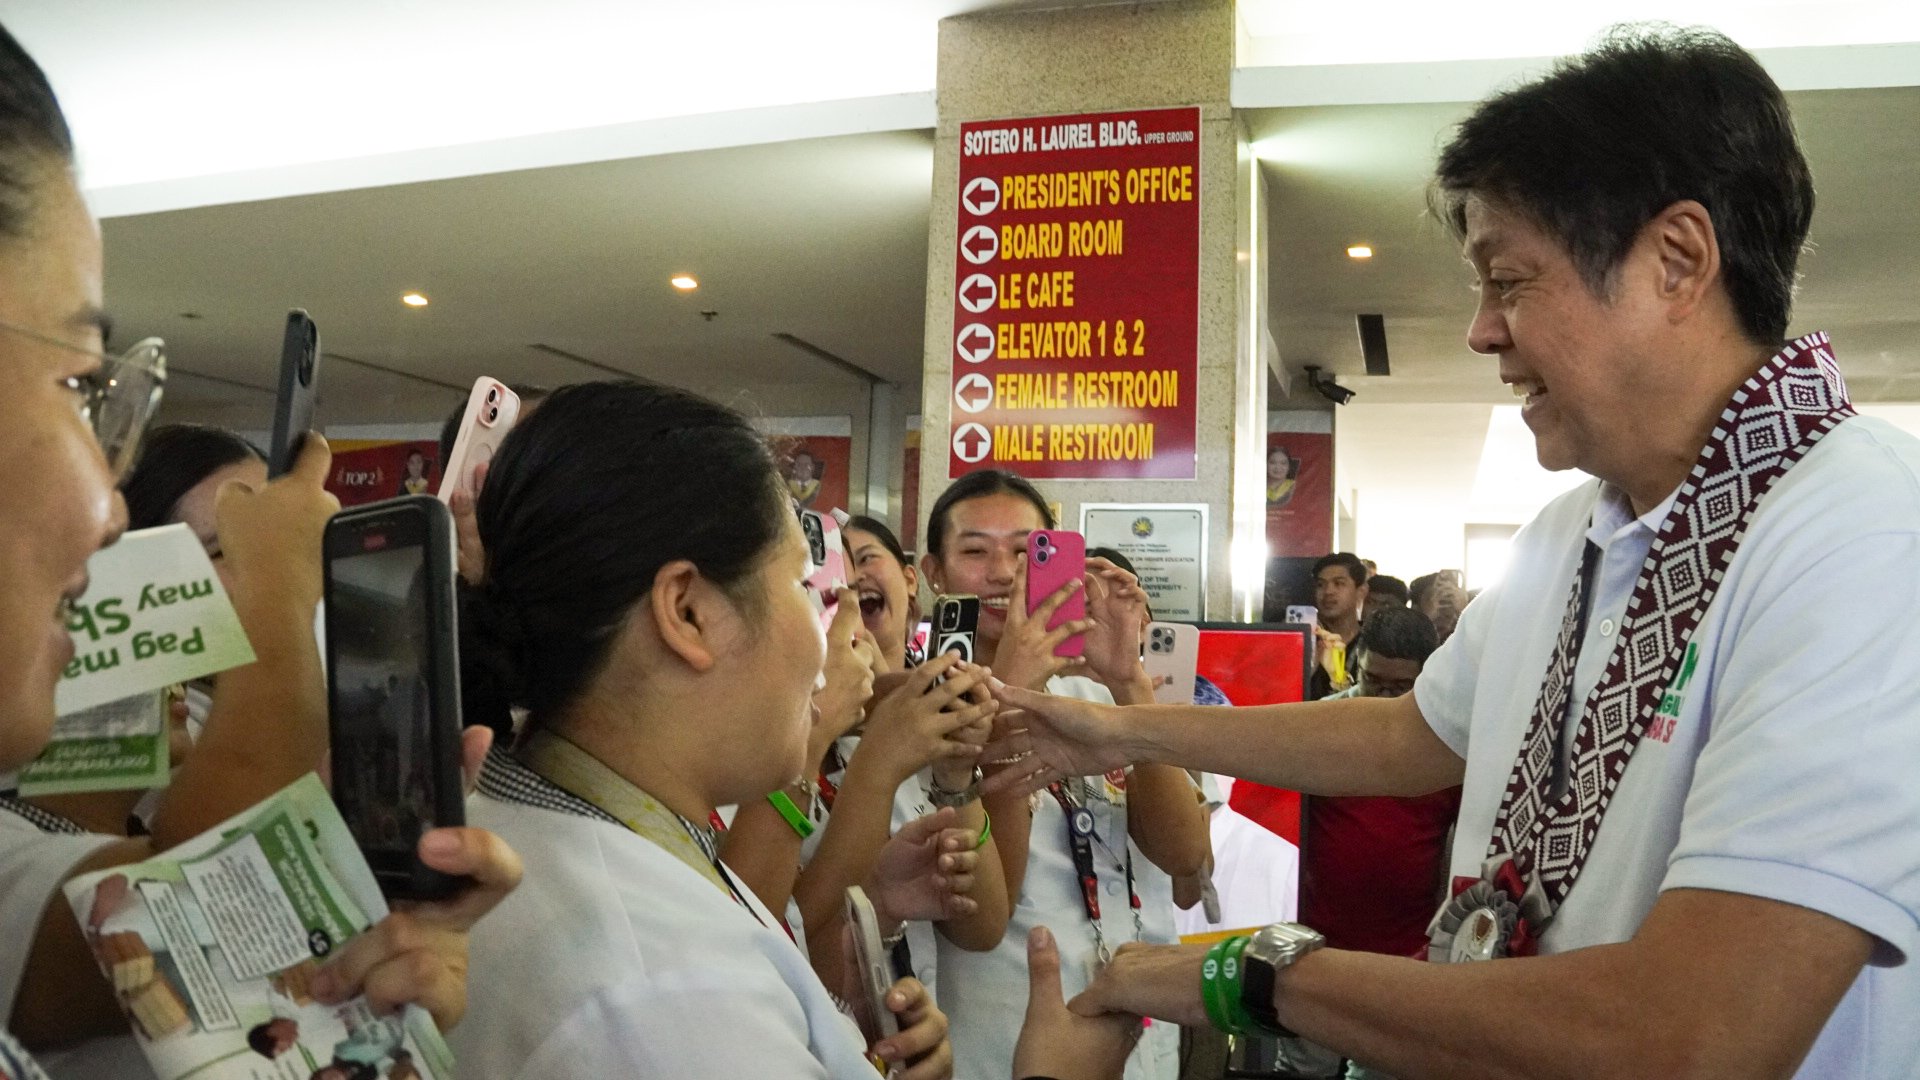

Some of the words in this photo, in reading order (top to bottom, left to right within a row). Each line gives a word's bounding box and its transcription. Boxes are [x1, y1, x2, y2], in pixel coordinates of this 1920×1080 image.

[964, 128, 1020, 157] SOTERO
[1023, 127, 1037, 152] H.
[1041, 123, 1096, 151] LAUREL
[1100, 120, 1142, 147] BLDG.
[1144, 133, 1166, 145] UPPER
[1166, 131, 1194, 143] GROUND
[1002, 170, 1120, 210] PRESIDENT'S
[1126, 166, 1192, 204] OFFICE
[1001, 223, 1063, 260] BOARD
[1068, 219, 1123, 257] ROOM
[1000, 273, 1021, 309] LE
[1026, 271, 1074, 308] CAFE
[997, 321, 1092, 359] ELEVATOR
[1097, 320, 1106, 356] 1
[1113, 319, 1127, 356] &
[1133, 319, 1145, 356] 2
[995, 373, 1068, 409] FEMALE
[1073, 370, 1178, 409] RESTROOM
[993, 424, 1043, 461] MALE
[1050, 423, 1153, 461] RESTROOM
[346, 471, 367, 485] TOP
[367, 471, 376, 485] 2
[137, 578, 213, 611] may
[131, 626, 205, 660] Pag
